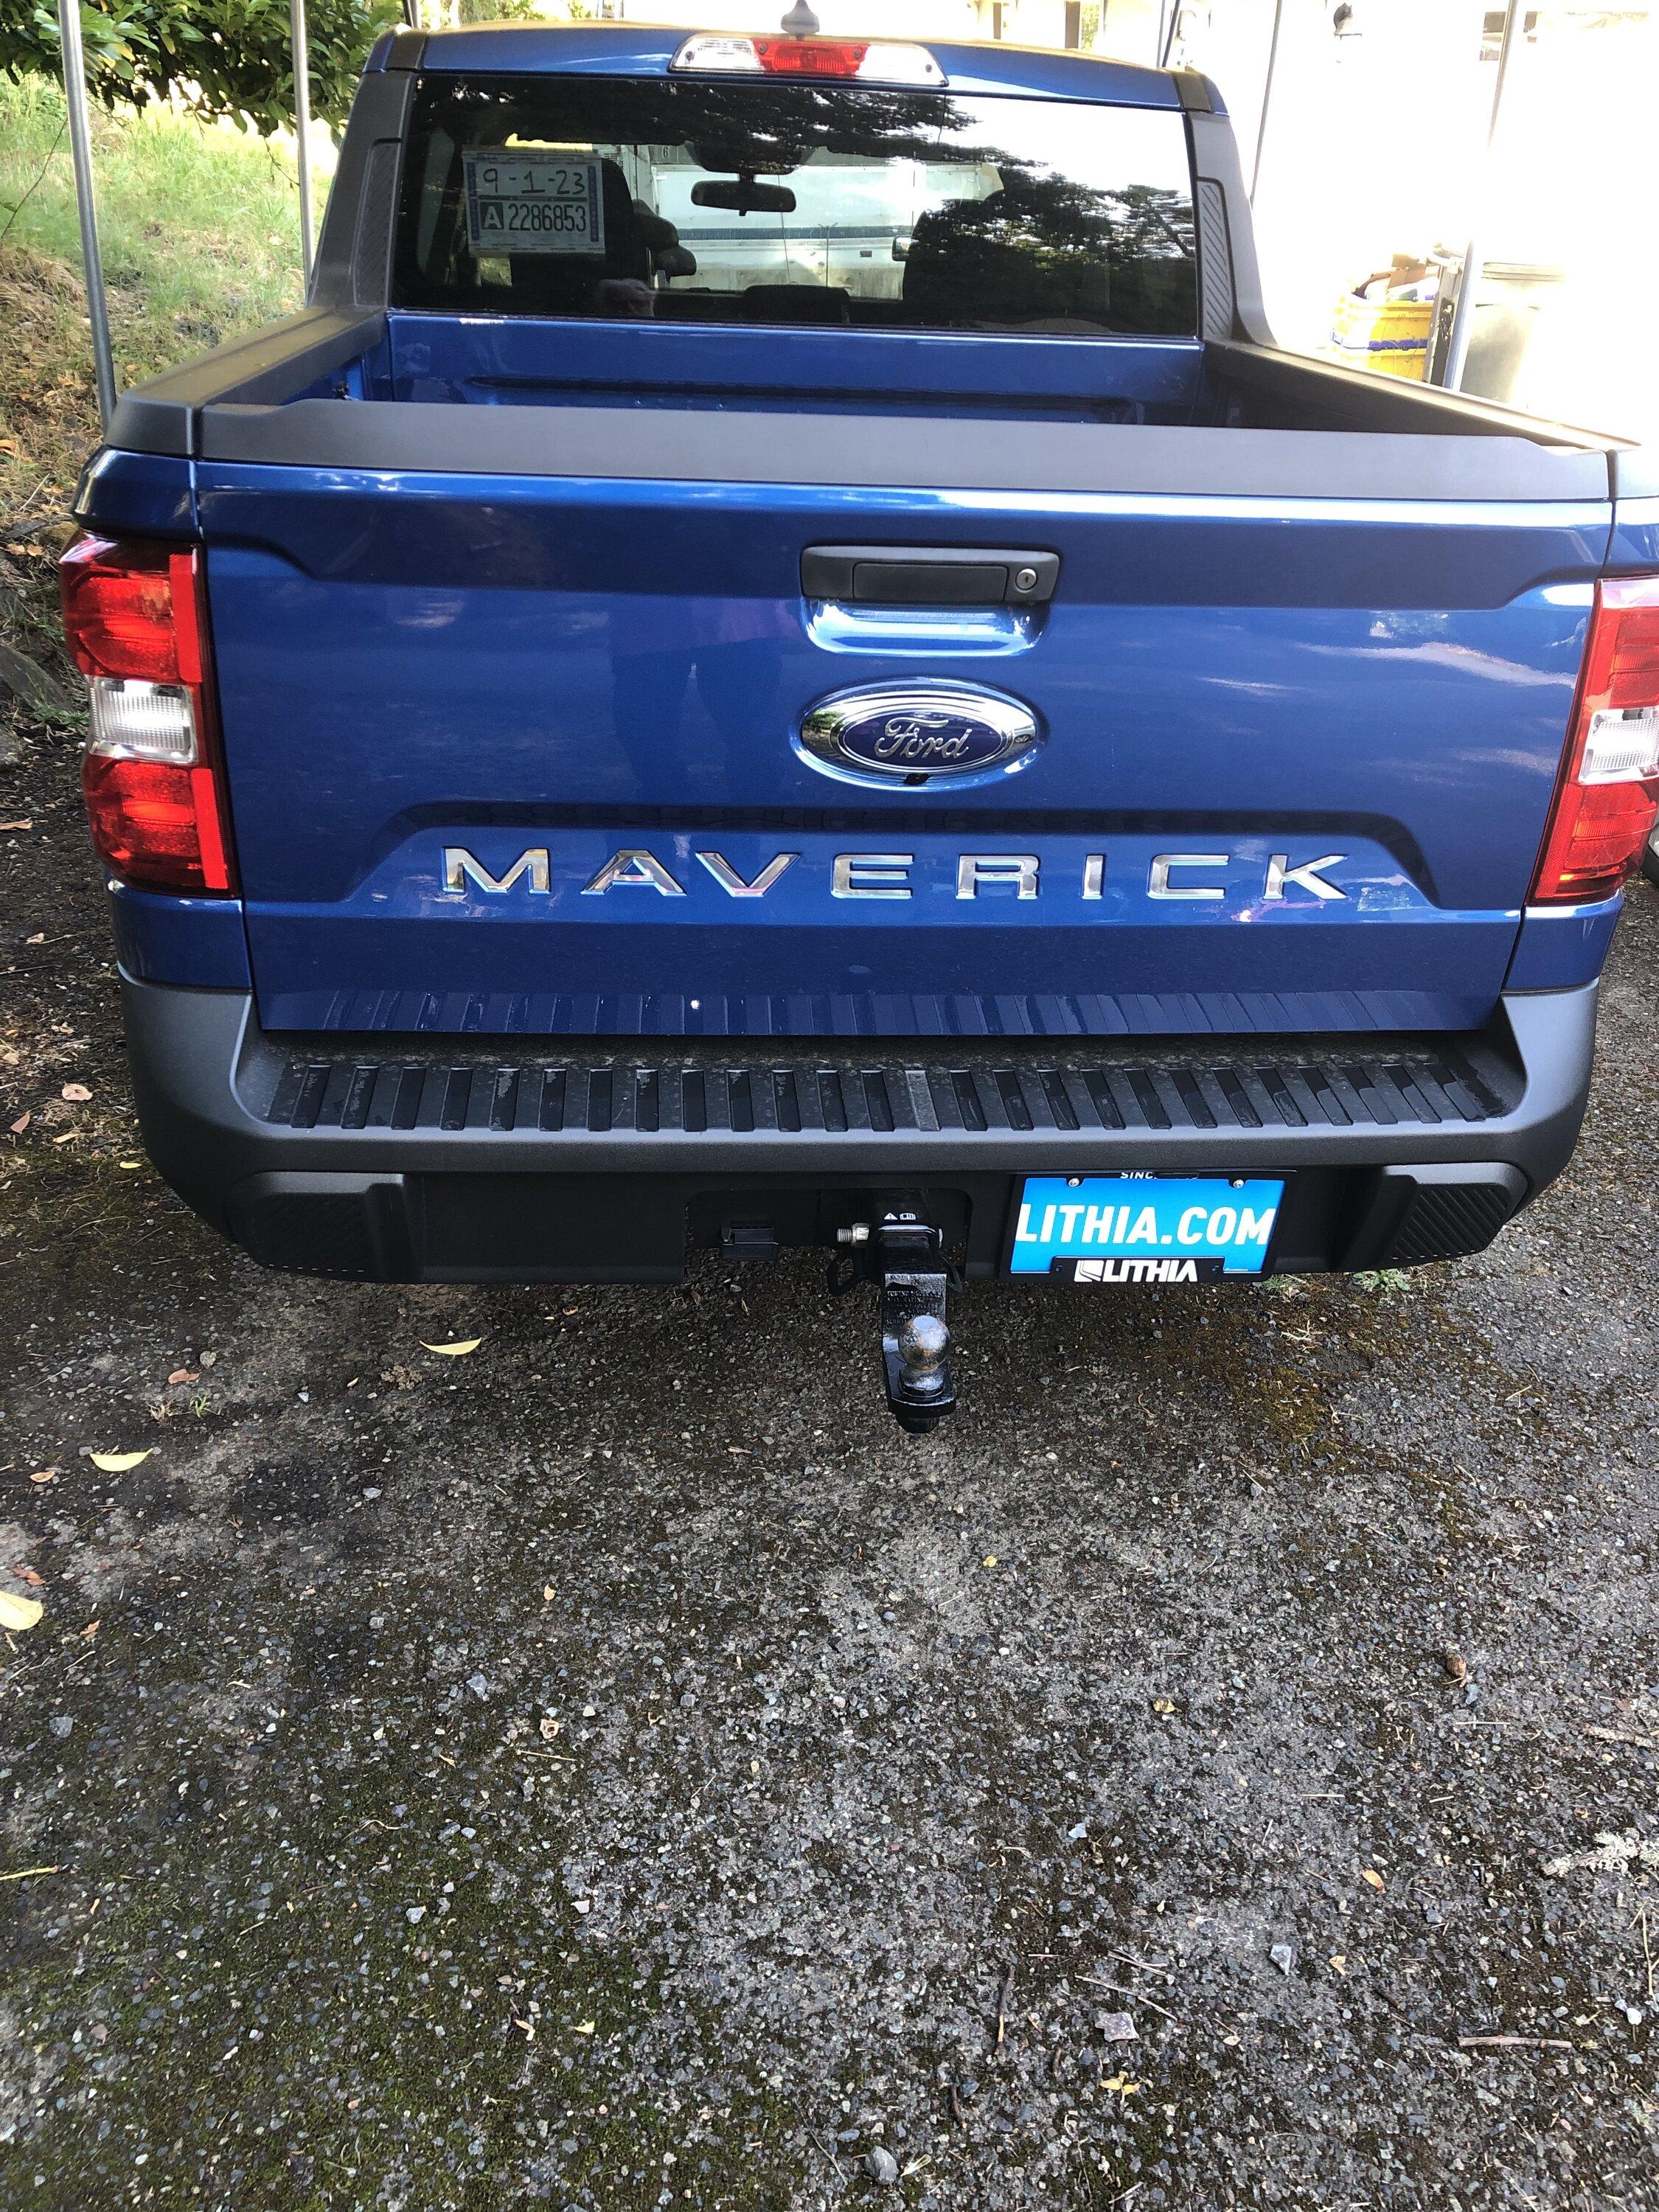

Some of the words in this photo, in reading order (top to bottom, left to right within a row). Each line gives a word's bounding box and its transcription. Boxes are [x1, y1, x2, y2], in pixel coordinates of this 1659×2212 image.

[508, 204, 587, 232] 2286853
[874, 716, 970, 759] Ford
[441, 846, 1349, 900] MAVERICK
[1120, 1171, 1158, 1179] SINC
[1015, 1203, 1276, 1245] LITHIA.COM
[1102, 1259, 1198, 1282] LITHIA
